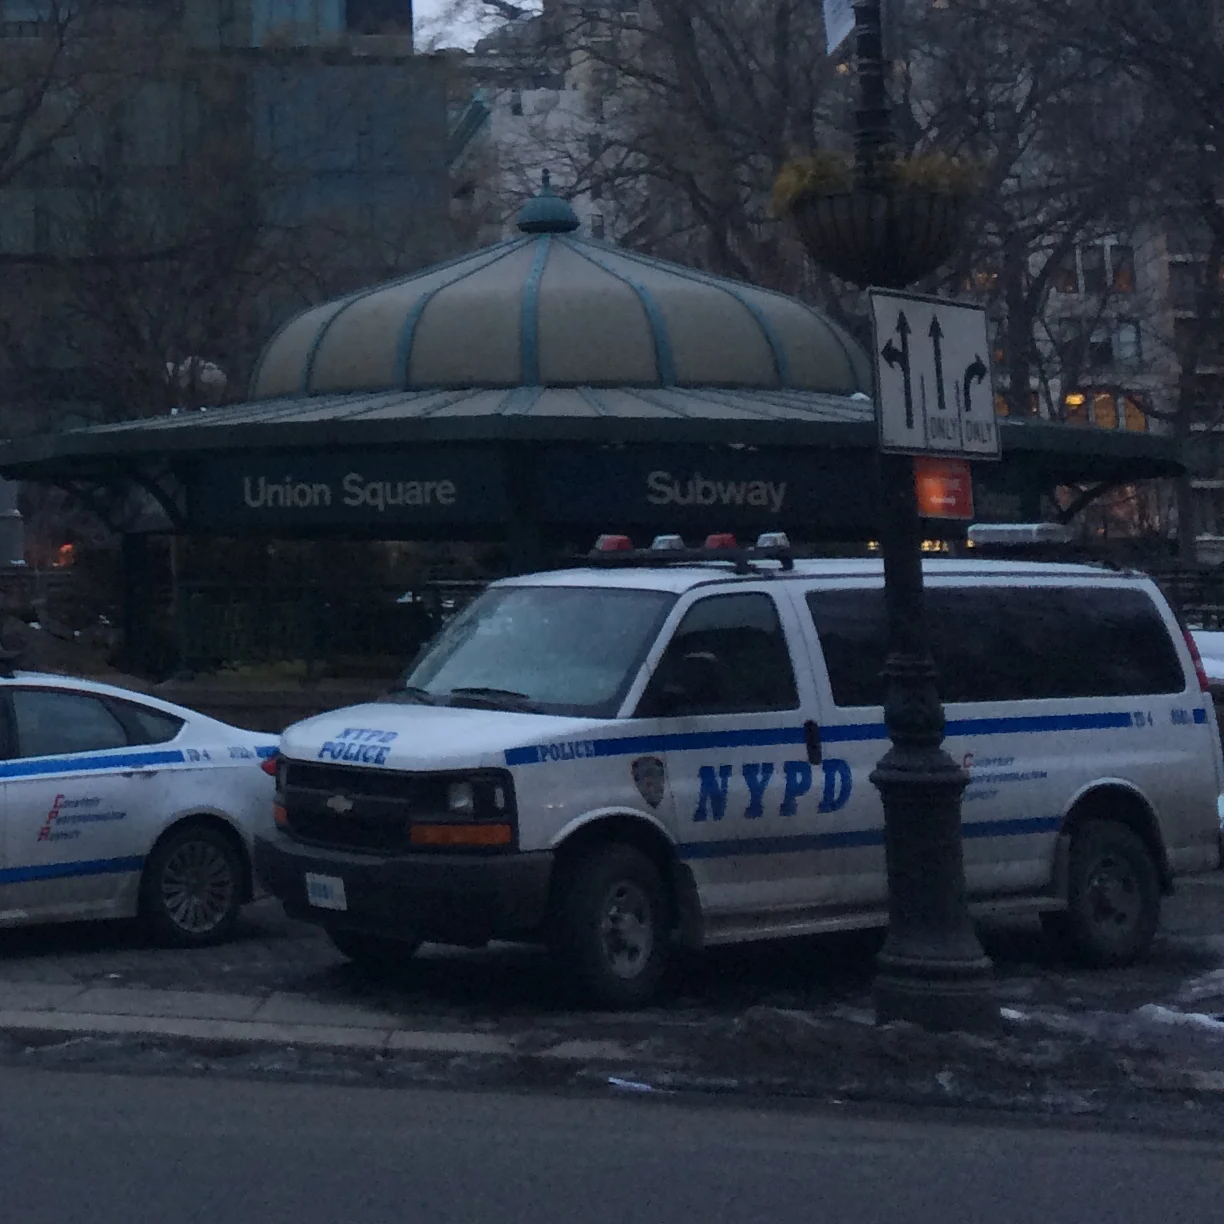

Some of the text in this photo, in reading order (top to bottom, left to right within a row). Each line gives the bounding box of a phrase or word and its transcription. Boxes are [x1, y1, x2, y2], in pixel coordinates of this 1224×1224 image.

[930, 416, 957, 440] ONLY
[965, 419, 992, 444] ONLY
[243, 471, 457, 512] Union Square
[645, 470, 788, 513] Subway
[318, 741, 392, 765] POLICE
[537, 740, 595, 762] POLICE
[693, 758, 853, 822] NYPD
